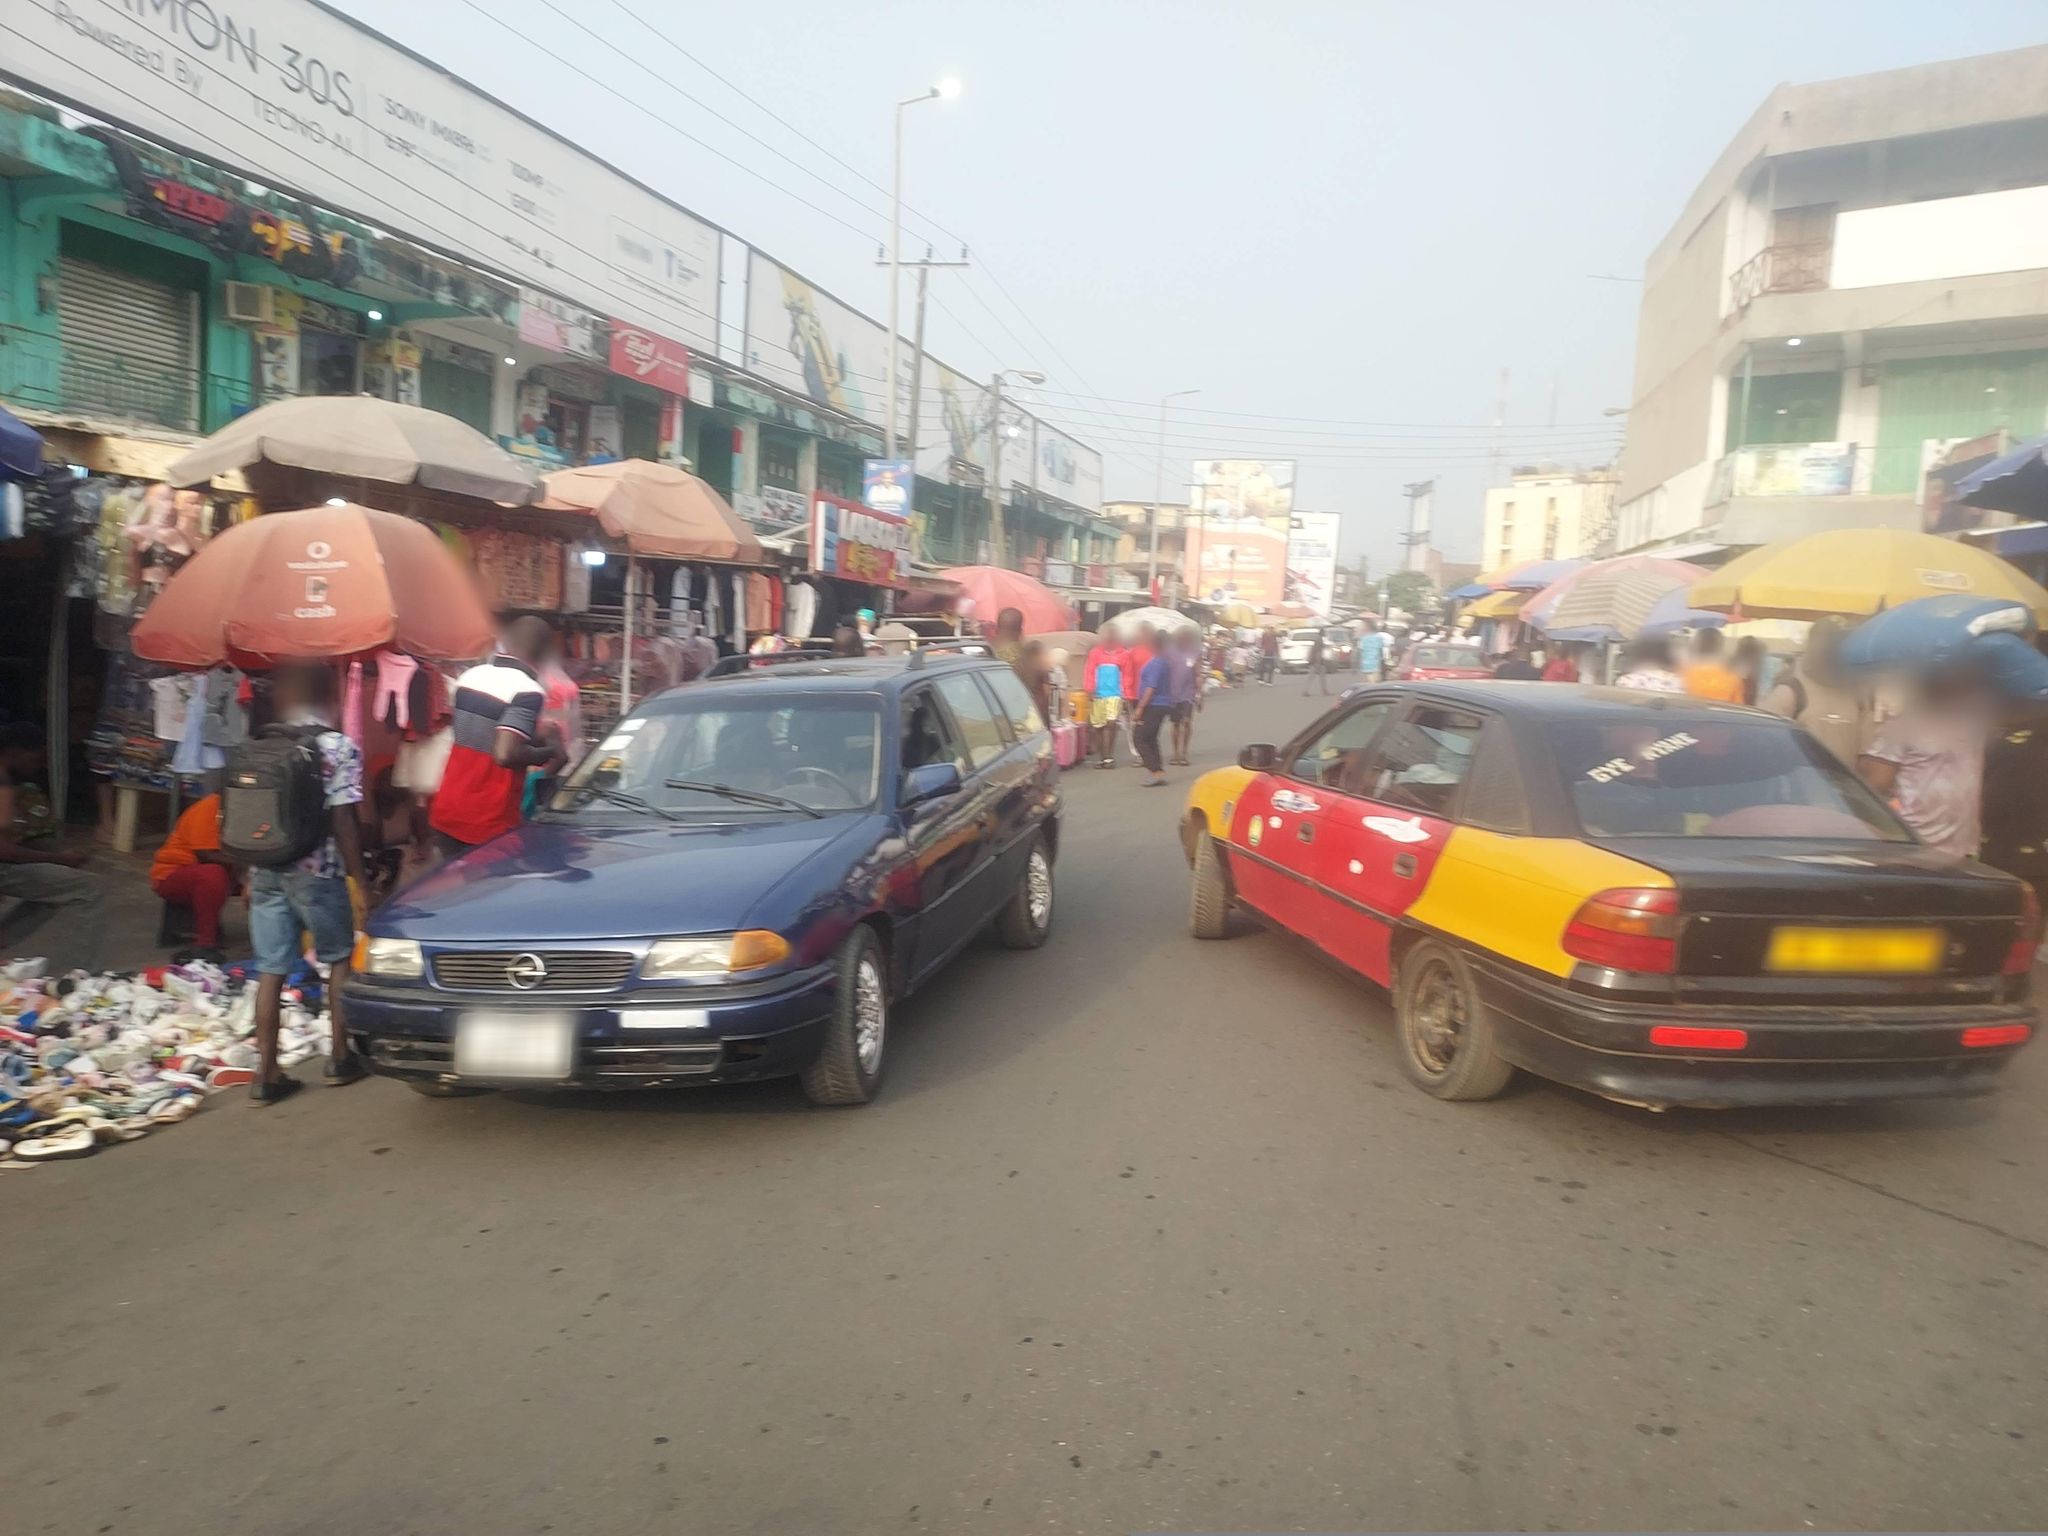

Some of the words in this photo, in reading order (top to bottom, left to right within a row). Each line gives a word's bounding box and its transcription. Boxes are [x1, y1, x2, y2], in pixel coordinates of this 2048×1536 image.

[54, 0, 165, 74] Powered
[174, 57, 203, 94] By
[280, 42, 354, 117] 30S
